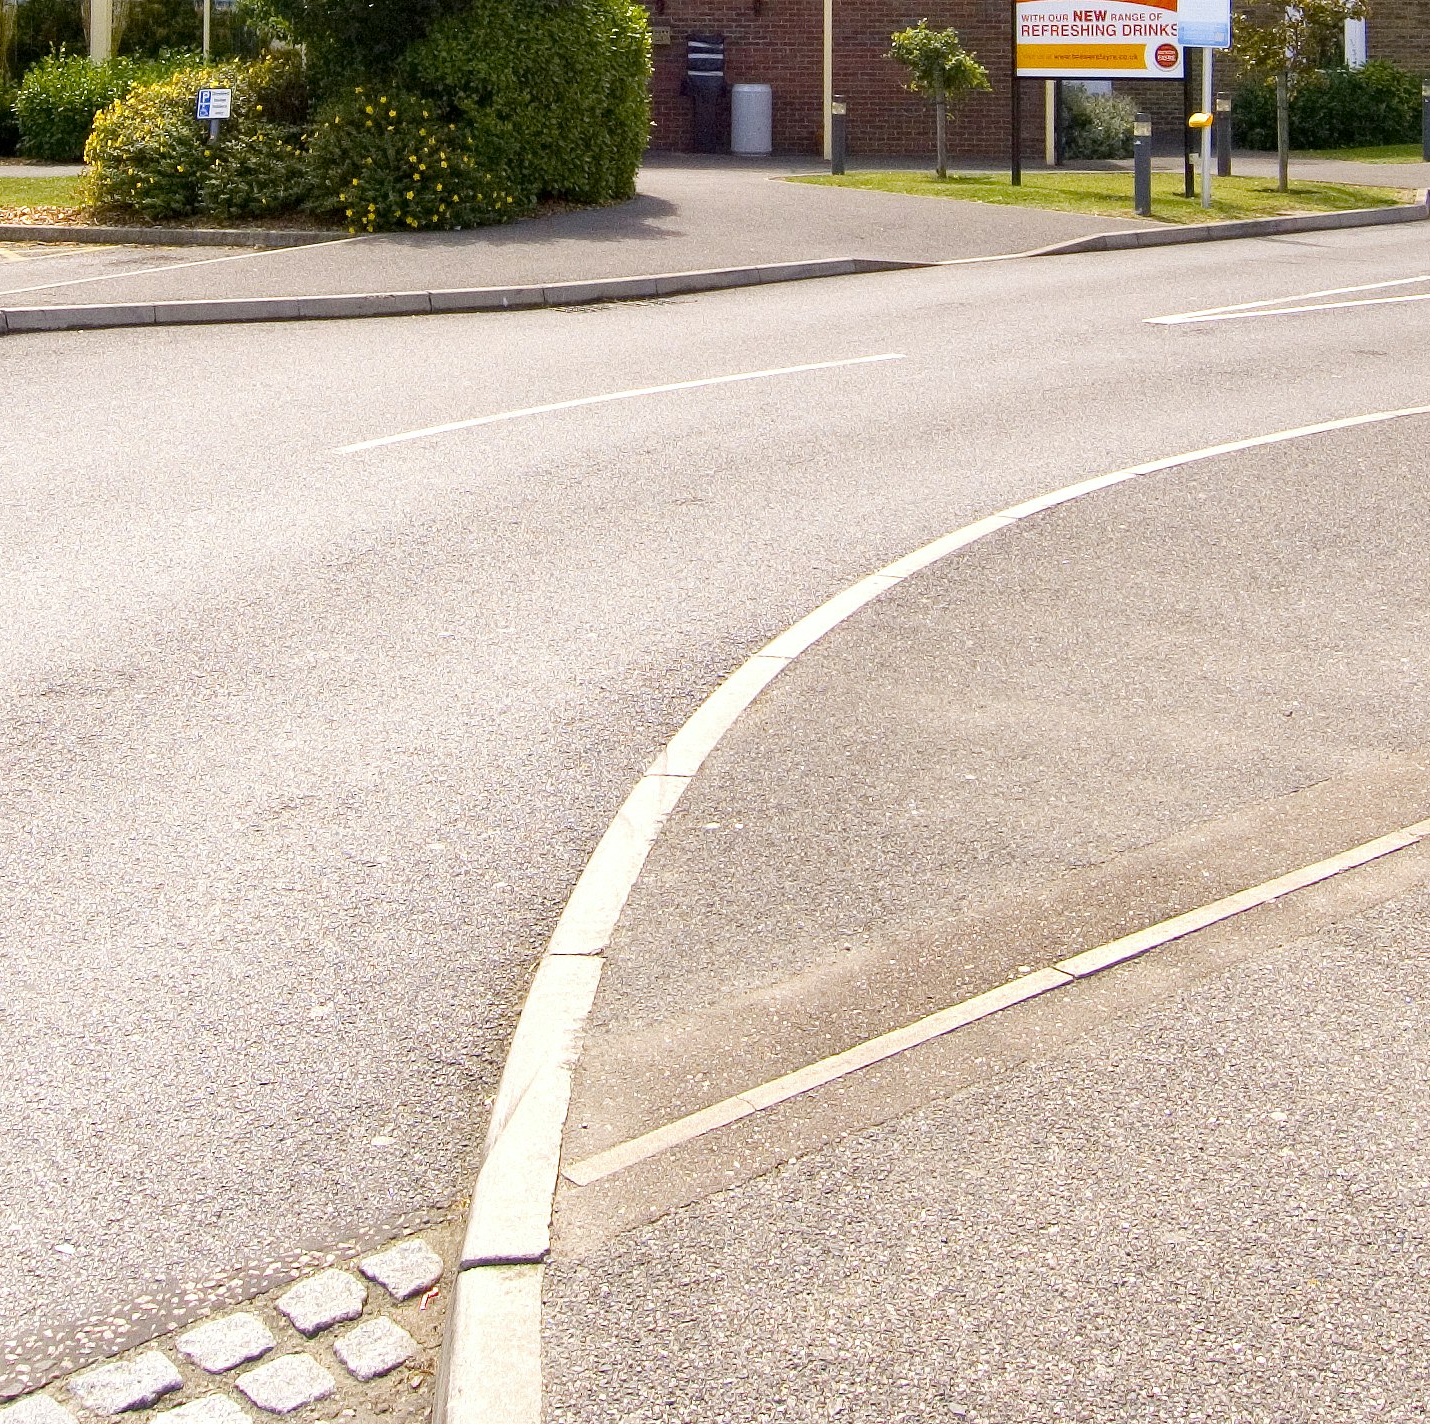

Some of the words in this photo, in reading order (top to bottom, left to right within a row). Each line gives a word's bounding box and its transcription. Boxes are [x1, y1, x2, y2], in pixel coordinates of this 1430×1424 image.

[1021, 14, 1045, 23] WITH
[1048, 13, 1069, 23] OUR
[1073, 10, 1108, 23] NEW
[1110, 13, 1145, 22] RANGE
[1149, 12, 1163, 22] OF
[1021, 24, 1117, 37] REFRESHING
[1122, 24, 1178, 37] DRINKS
